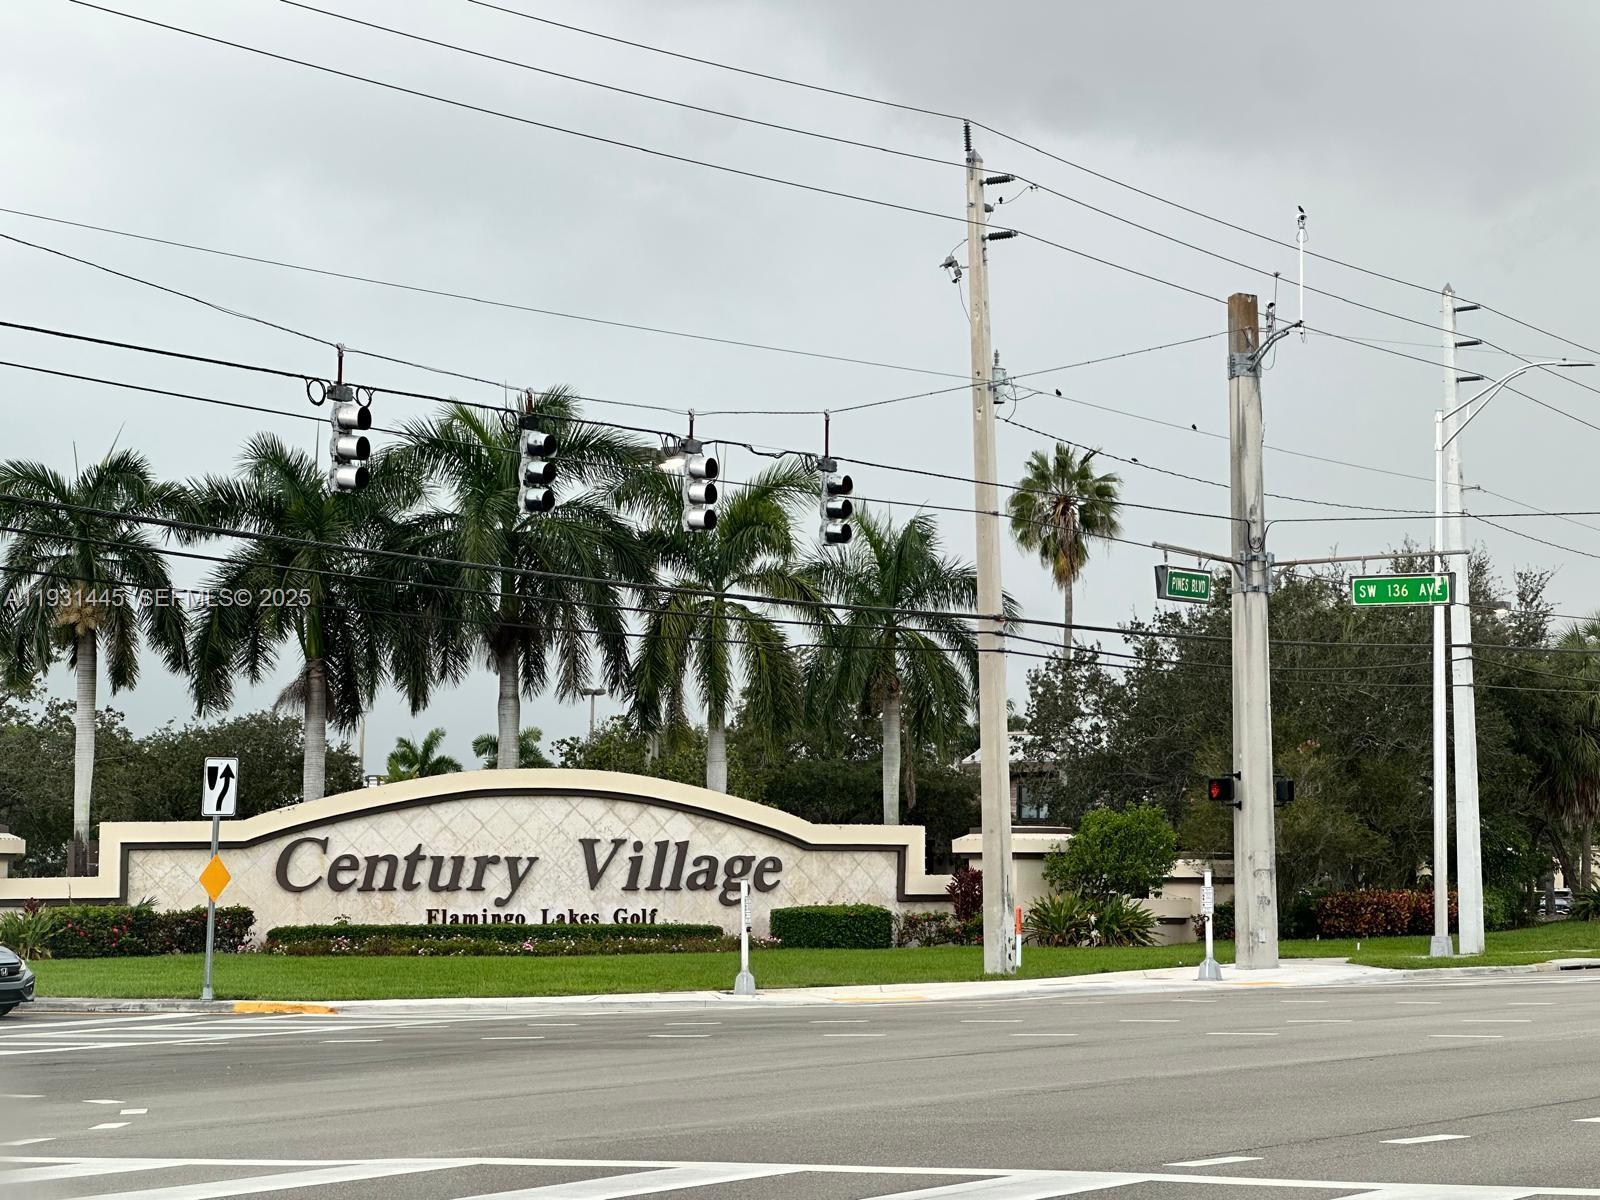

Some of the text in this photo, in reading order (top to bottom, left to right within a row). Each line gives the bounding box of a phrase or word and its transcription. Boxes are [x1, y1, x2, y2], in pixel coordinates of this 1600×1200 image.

[1171, 577, 1206, 593] PINES BLVD
[1359, 583, 1443, 598] SW 136 AVE
[275, 836, 783, 906] Century Village
[426, 908, 659, 925] Flamingo Lakes Golf
